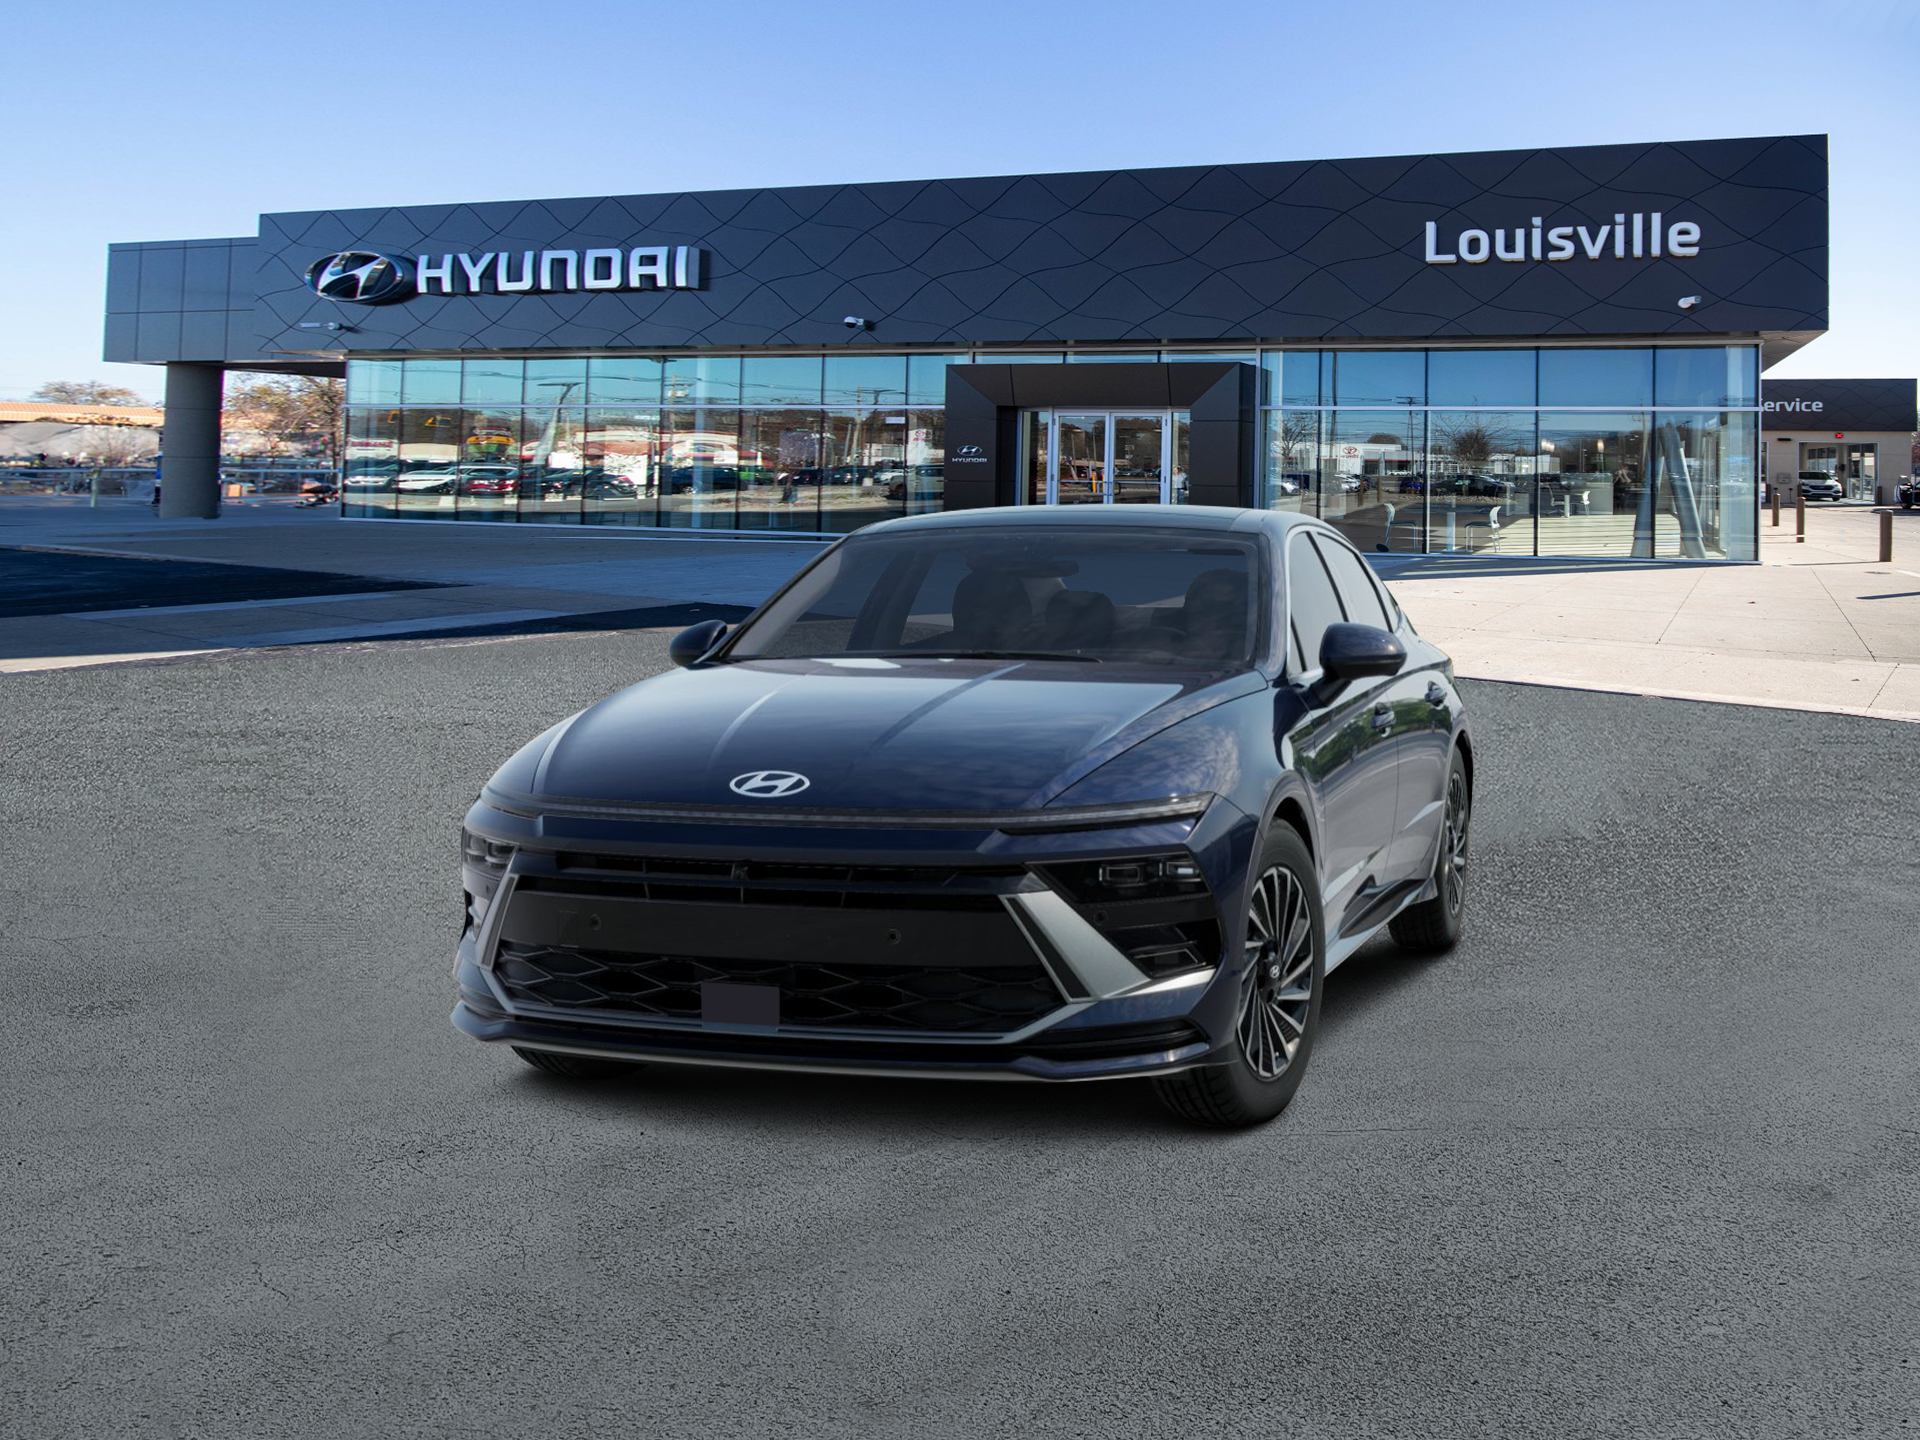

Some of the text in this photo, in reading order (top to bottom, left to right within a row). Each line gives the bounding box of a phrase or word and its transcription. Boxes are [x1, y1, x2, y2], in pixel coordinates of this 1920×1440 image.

[1425, 212, 1701, 264] Louisville
[416, 245, 698, 294] HYUNDAI
[1760, 397, 1823, 412] ervice
